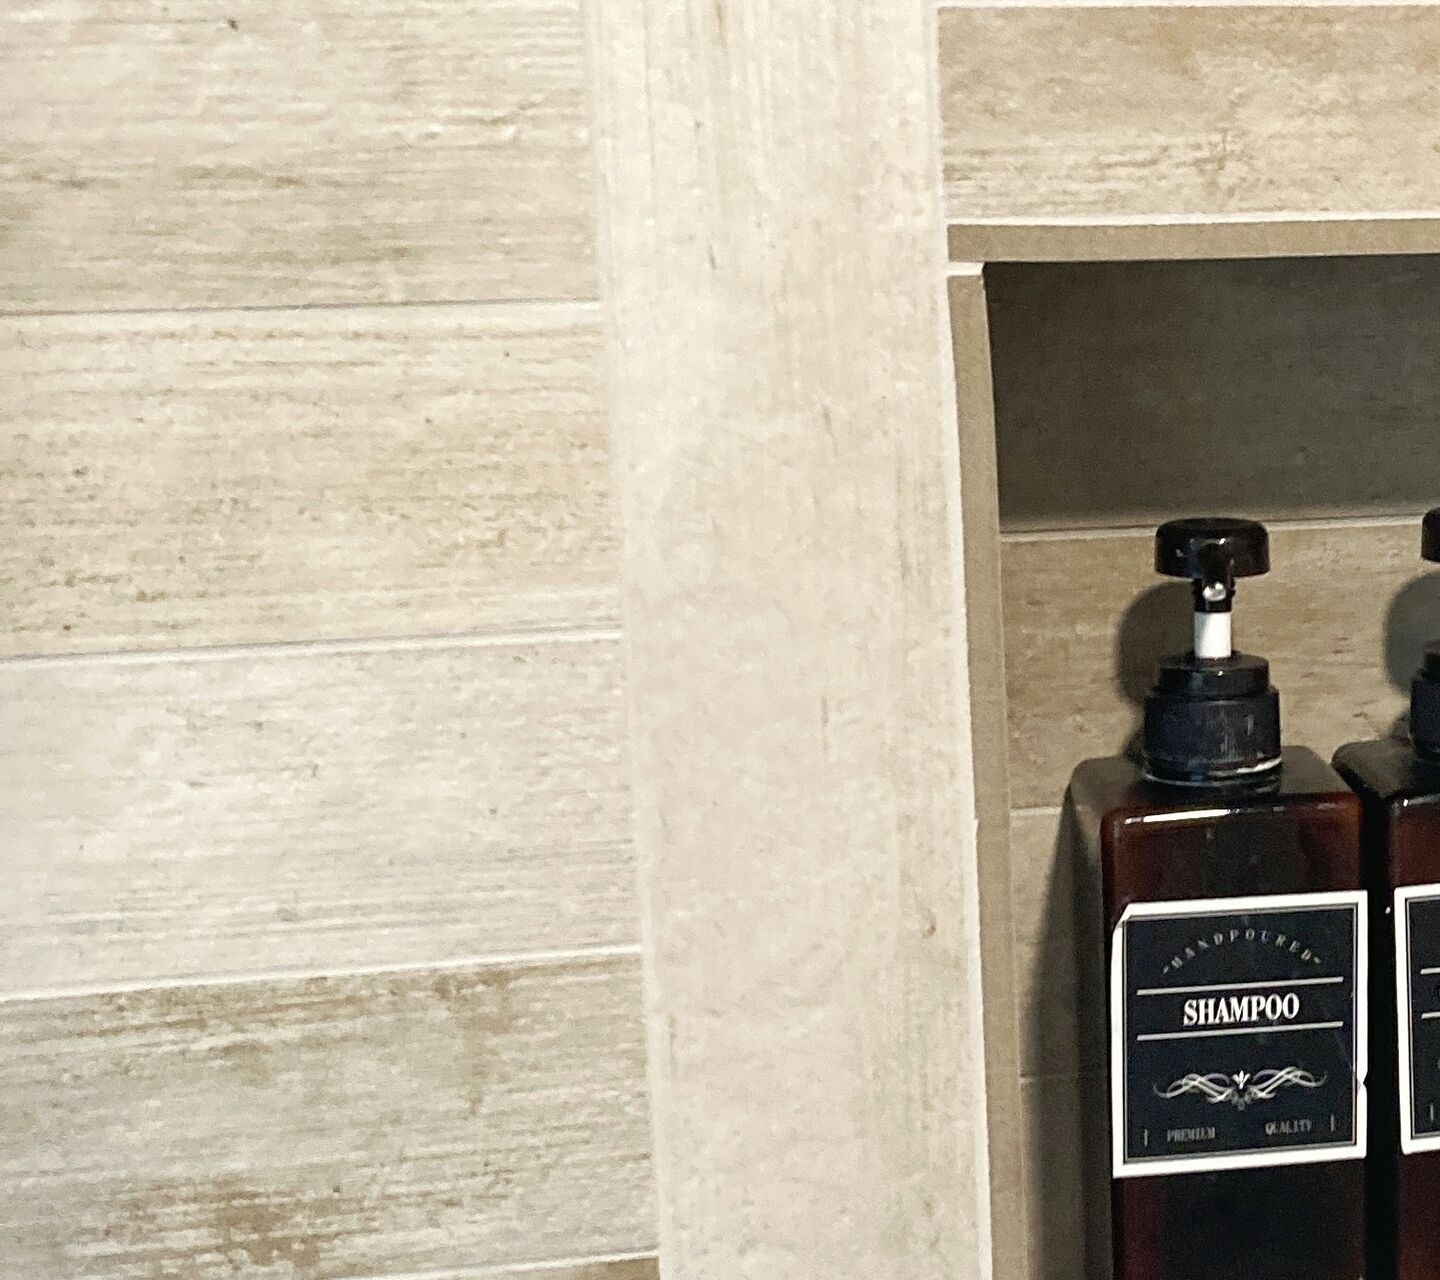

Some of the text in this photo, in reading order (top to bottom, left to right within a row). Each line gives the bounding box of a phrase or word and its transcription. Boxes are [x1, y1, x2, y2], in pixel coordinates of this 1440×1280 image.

[1182, 993, 1300, 1026] SHAMPOO
[1166, 1119, 1312, 1143] PREMIUM QUALITY
